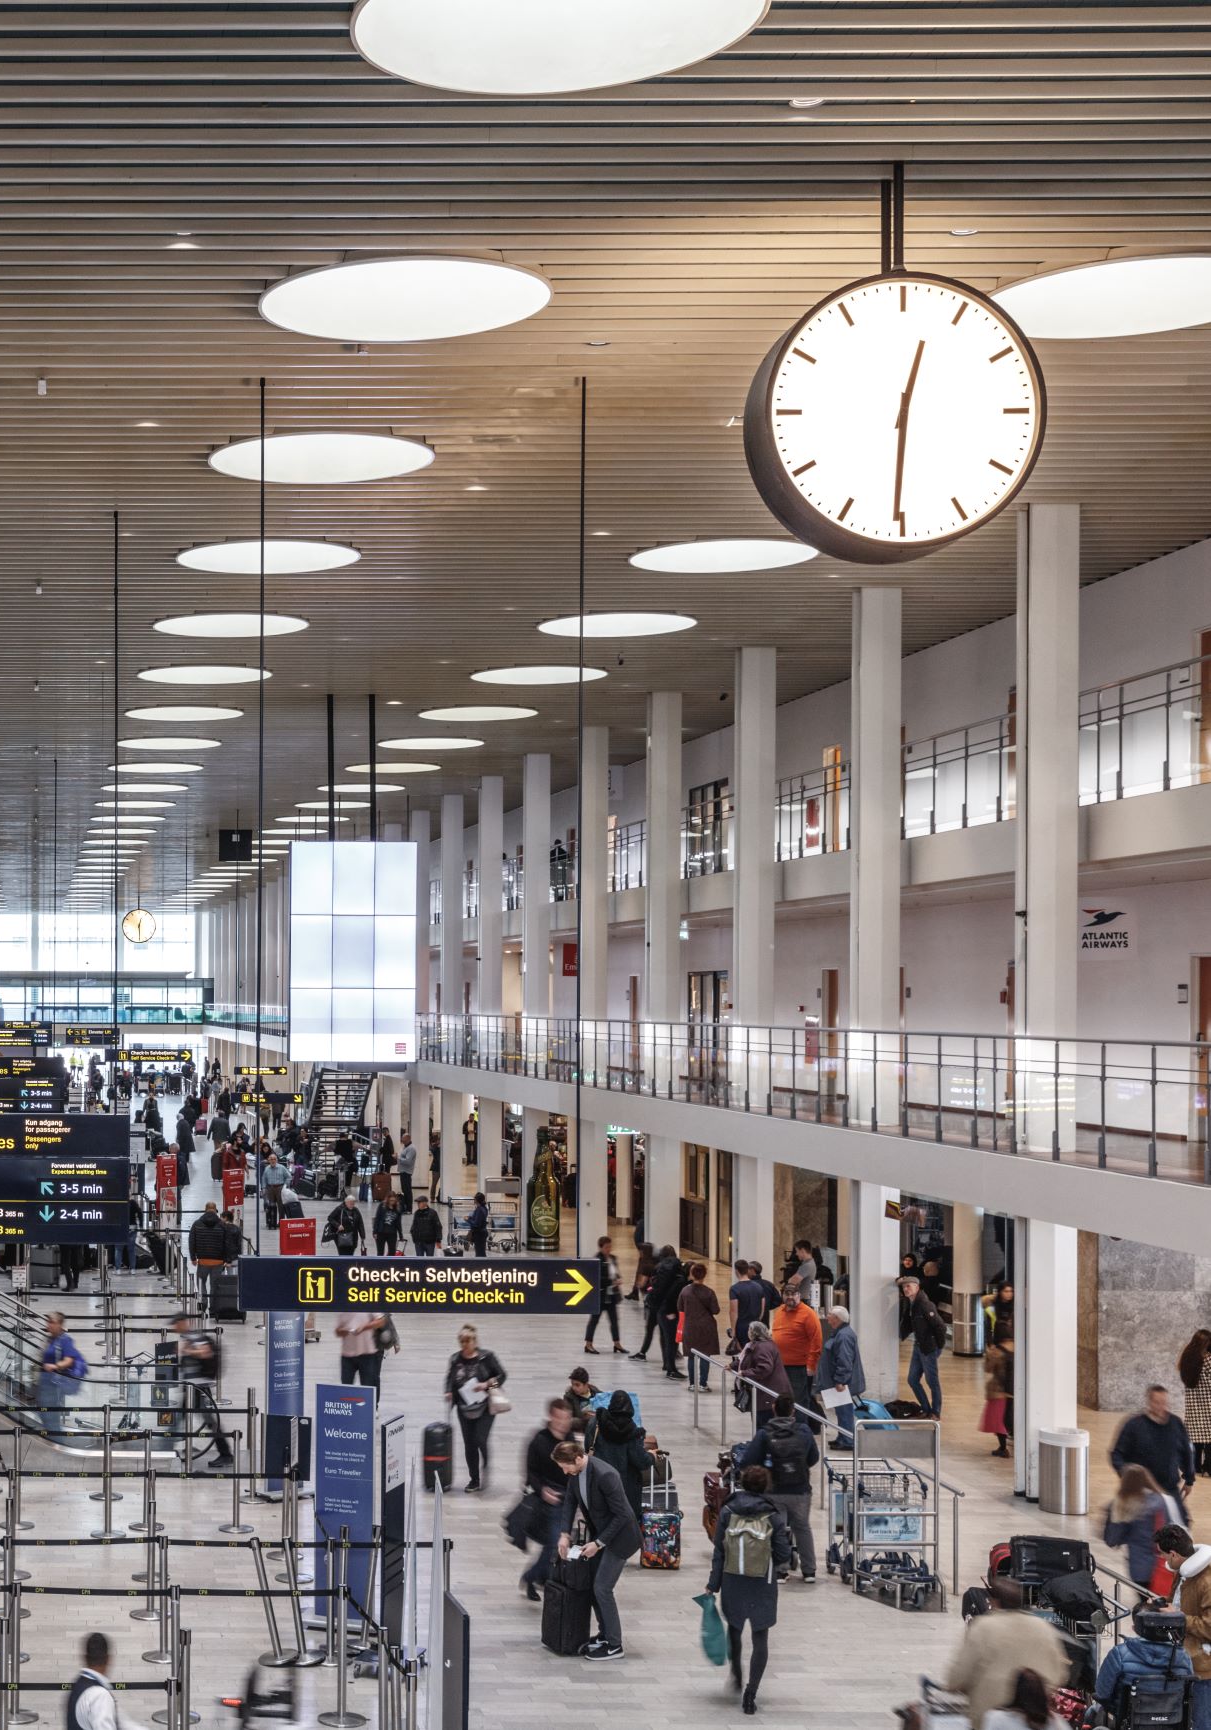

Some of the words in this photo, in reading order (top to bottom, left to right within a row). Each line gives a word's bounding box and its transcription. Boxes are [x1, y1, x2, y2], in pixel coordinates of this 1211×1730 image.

[1081, 940, 1129, 949] AIRWAYS
[39, 1120, 63, 1128] adgang
[25, 1136, 62, 1144] Passengers
[60, 1184, 79, 1194] 3-5
[82, 1184, 103, 1194] min
[60, 1209, 79, 1220] 2-4
[82, 1209, 103, 1219] min
[348, 1267, 420, 1282] Check-in
[425, 1268, 538, 1286] Selvbetjening
[348, 1287, 380, 1302] Self
[385, 1288, 447, 1303] Service
[452, 1288, 525, 1303] Check-in
[274, 1340, 301, 1349] Welcome
[324, 1401, 352, 1410] BRITISH
[324, 1408, 353, 1416] AIRWAYS
[324, 1427, 368, 1440] Welcome
[338, 1468, 362, 1476] Traveller
